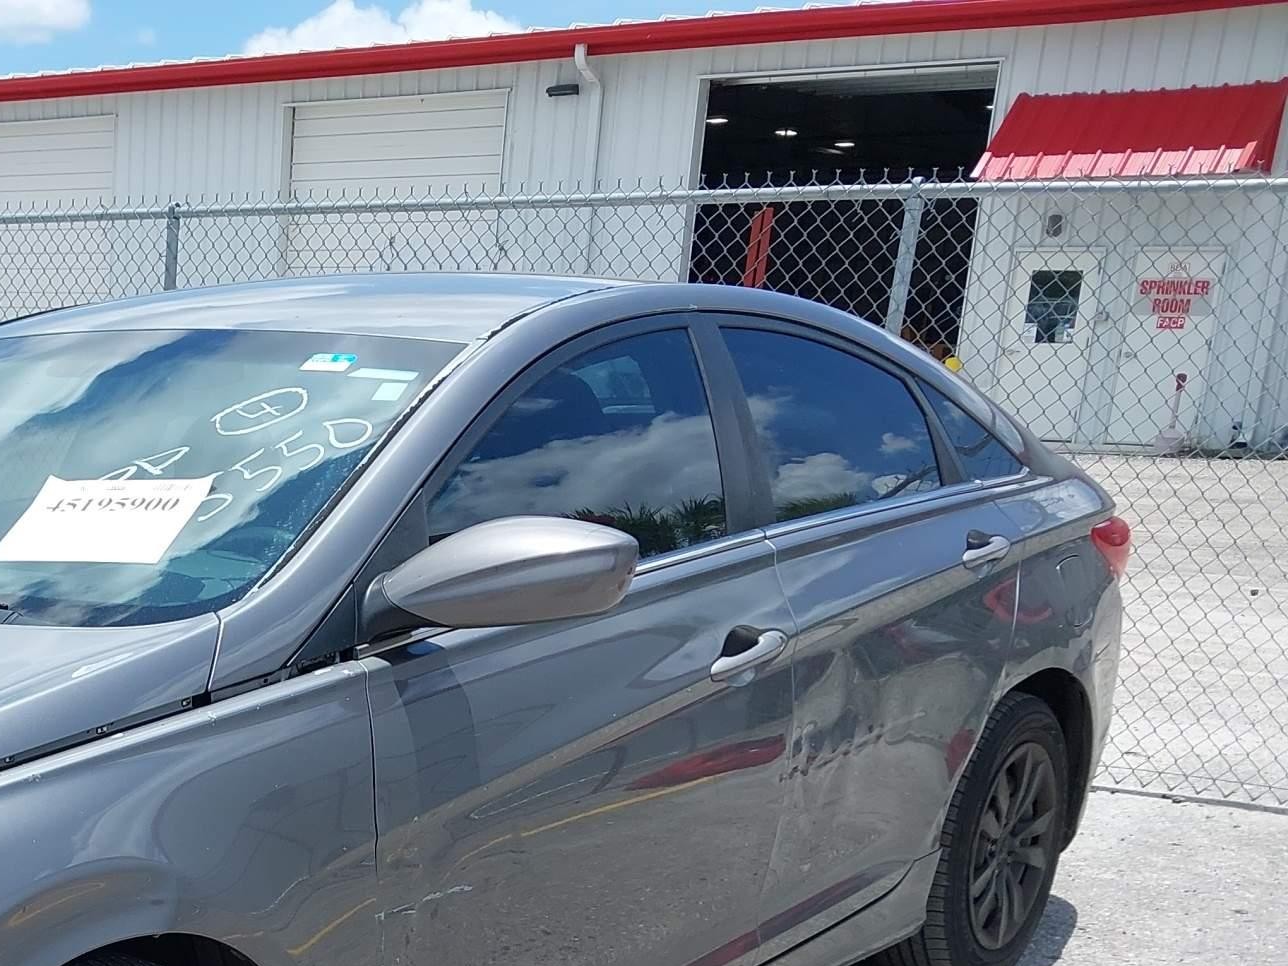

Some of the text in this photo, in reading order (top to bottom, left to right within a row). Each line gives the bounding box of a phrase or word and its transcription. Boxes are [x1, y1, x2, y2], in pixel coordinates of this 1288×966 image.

[1139, 280, 1211, 296] SPRINKLER
[1152, 298, 1192, 314] ROOM
[1157, 317, 1185, 329] FACP
[45, 496, 181, 513] 45195900
